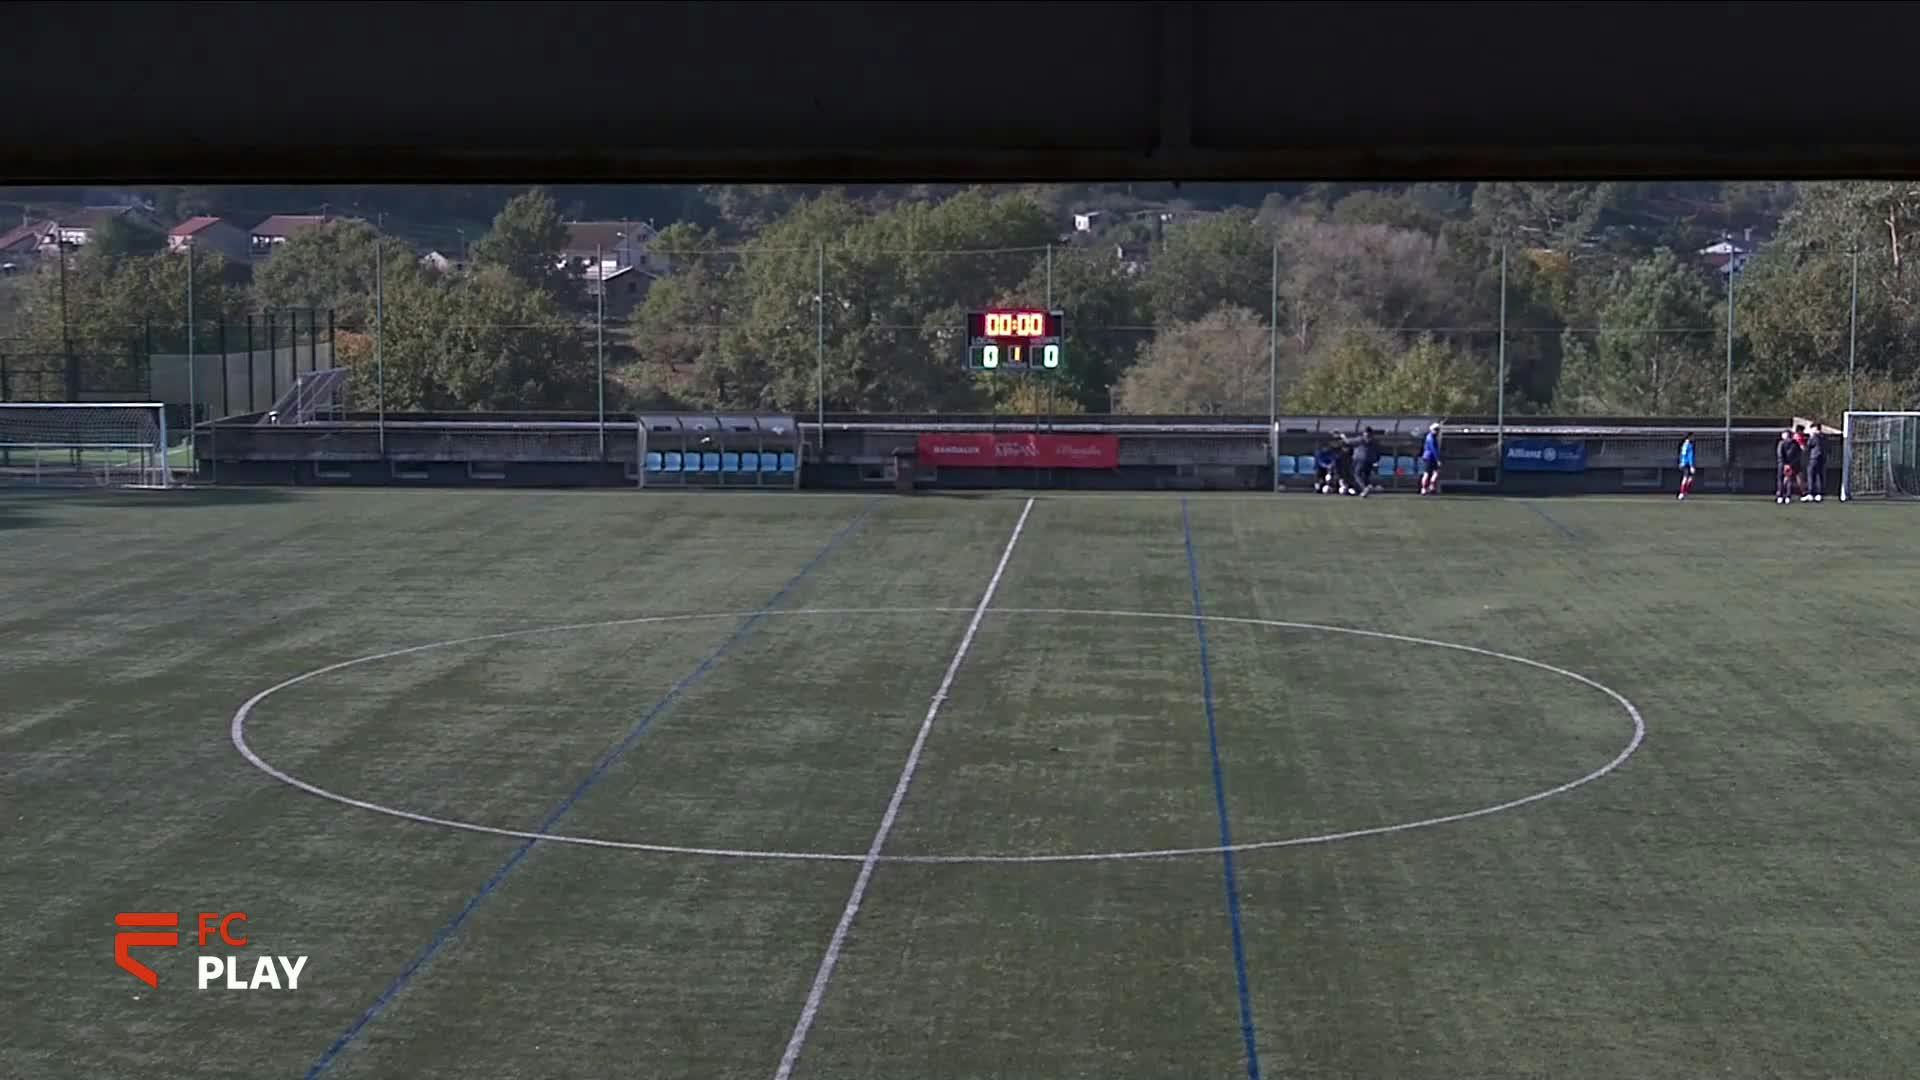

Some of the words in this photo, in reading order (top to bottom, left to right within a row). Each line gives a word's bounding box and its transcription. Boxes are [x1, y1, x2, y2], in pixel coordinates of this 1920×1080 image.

[986, 313, 1043, 336] 00:00
[983, 345, 999, 368] 0
[1014, 346, 1020, 361] 1
[1044, 345, 1059, 368] 0
[1507, 447, 1542, 459] Allianz
